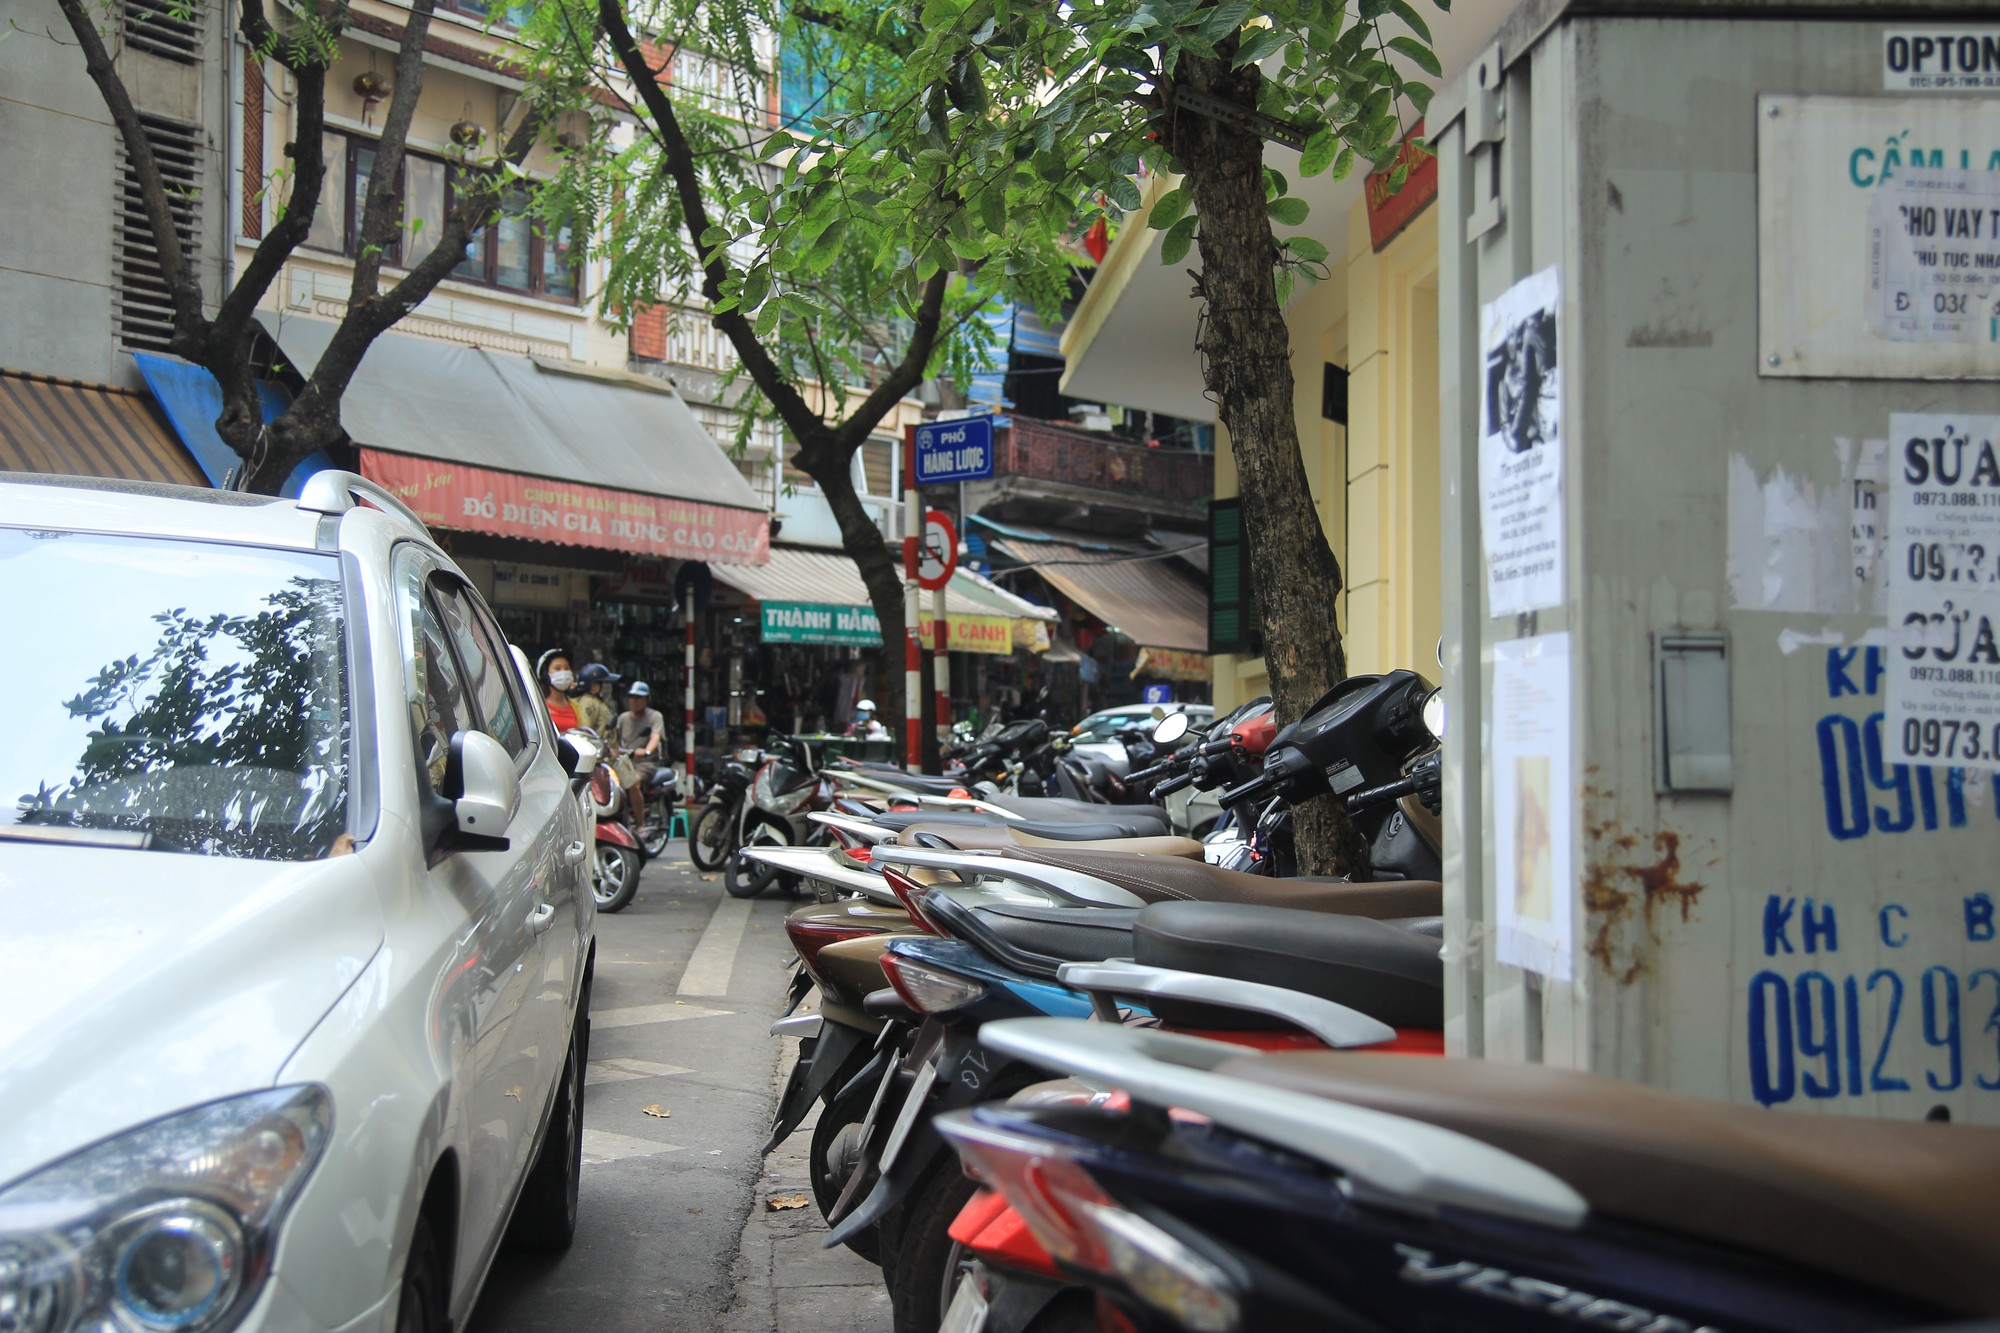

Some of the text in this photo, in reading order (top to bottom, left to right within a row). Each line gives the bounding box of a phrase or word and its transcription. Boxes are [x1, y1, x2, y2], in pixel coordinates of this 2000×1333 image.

[1944, 208, 1983, 239] VAY
[1943, 252, 1969, 270] TỤC
[941, 425, 966, 444] PHỐ
[923, 446, 985, 474] HÀNG LƯỢC
[1913, 491, 2000, 506] 0973.088.11
[463, 491, 497, 519] ĐỒ
[503, 502, 559, 529] ĐIỆN
[563, 512, 603, 535] GIA
[609, 517, 667, 543] DỤNG
[673, 528, 715, 549] CAO
[766, 606, 831, 629] THÀNH
[1763, 895, 1838, 957] KH
[1879, 904, 1909, 948] C
